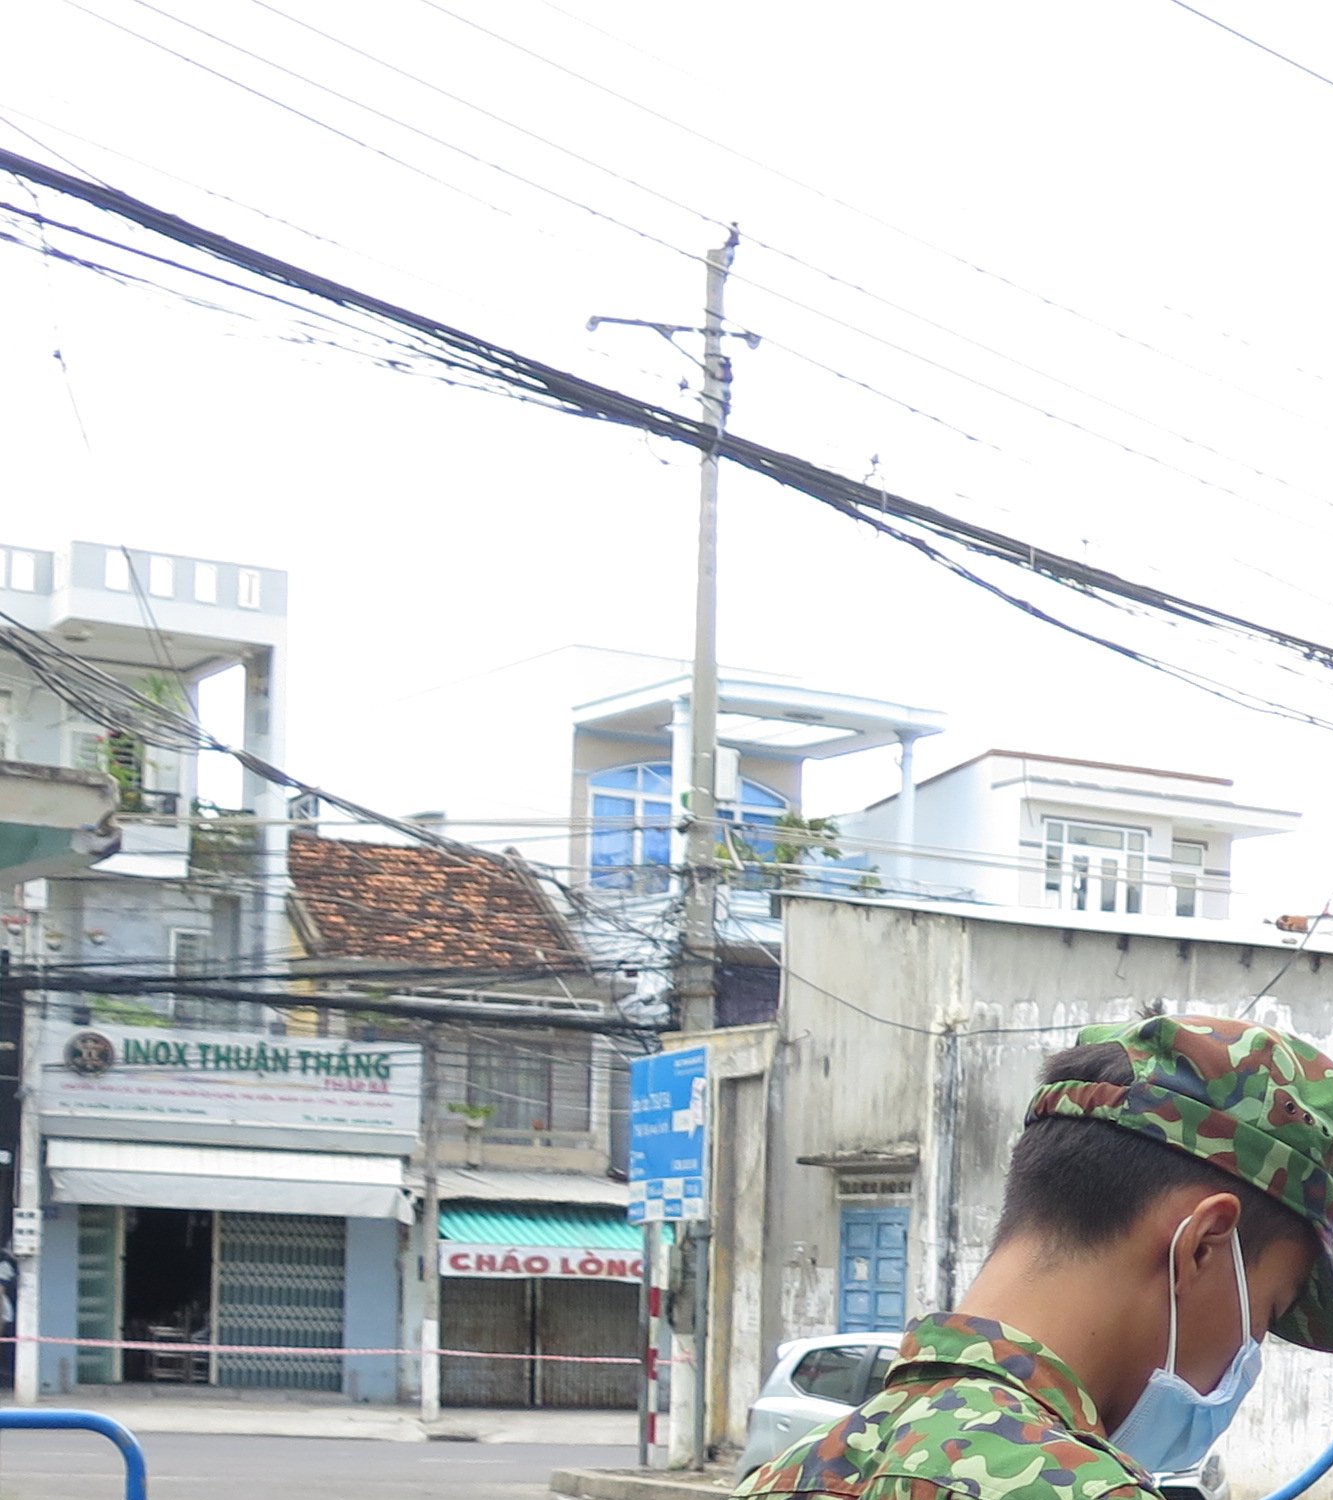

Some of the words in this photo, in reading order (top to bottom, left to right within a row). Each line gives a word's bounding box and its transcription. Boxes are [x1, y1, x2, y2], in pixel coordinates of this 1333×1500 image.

[122, 1038, 188, 1067] INOX
[197, 1041, 289, 1078] THUẬN
[449, 1248, 549, 1274] CHÁO
